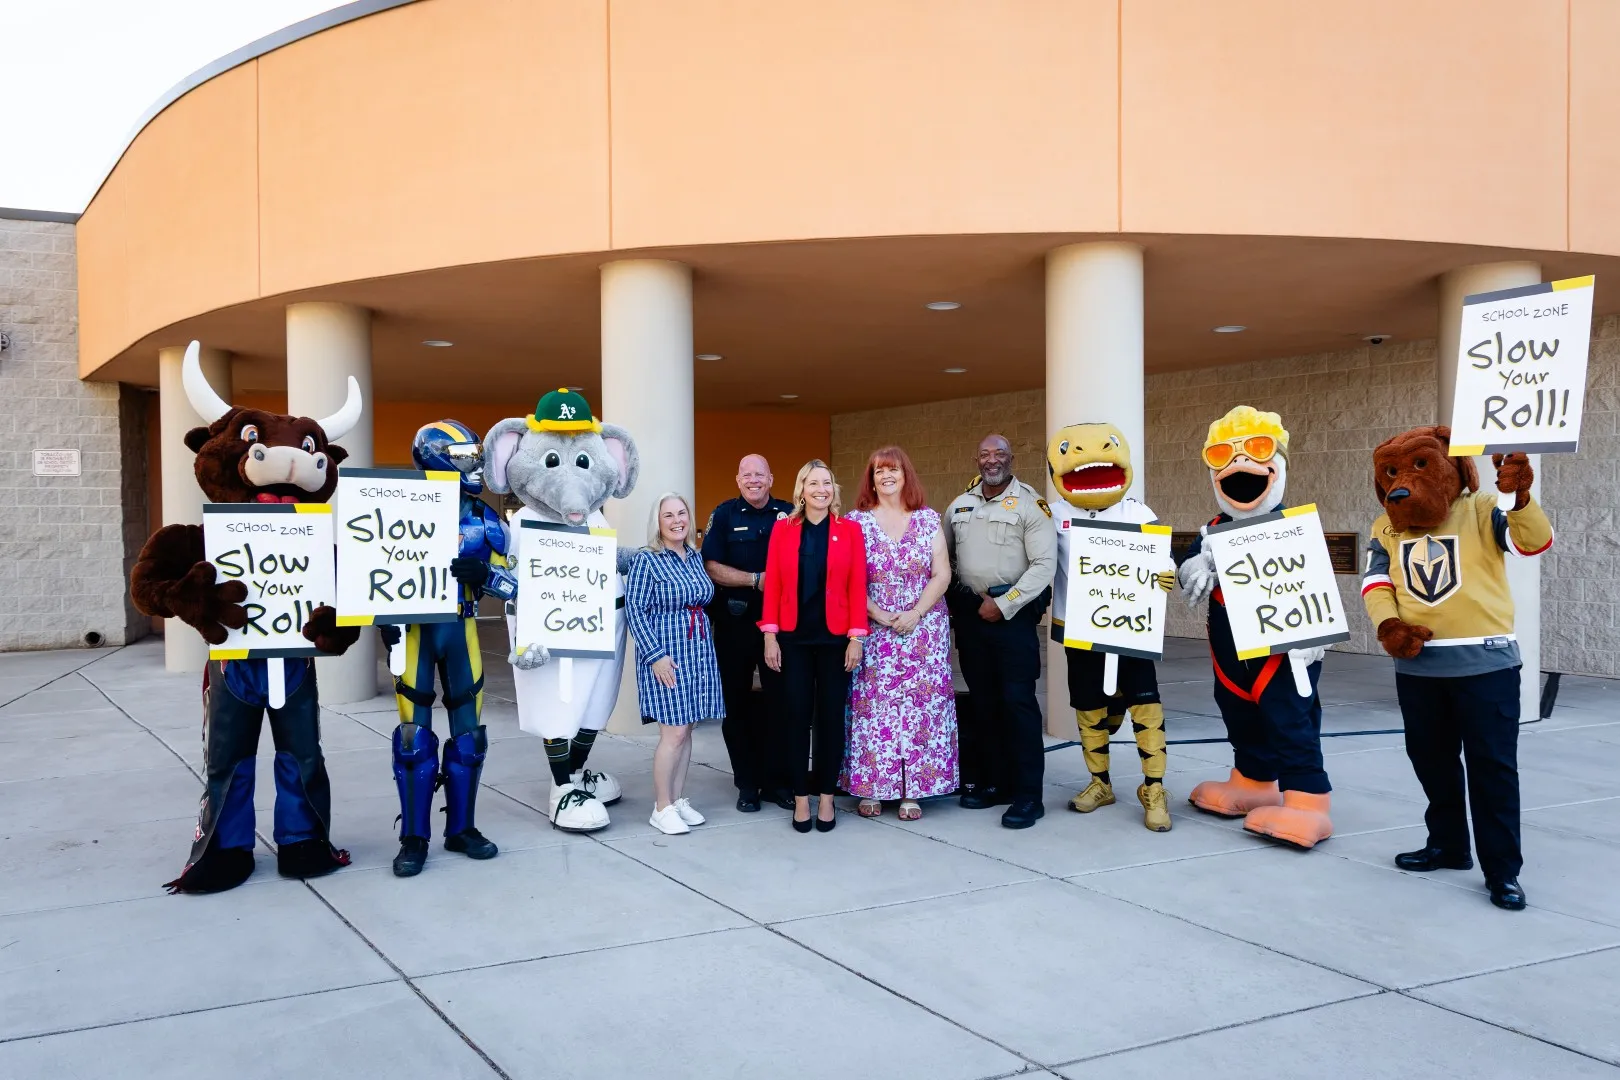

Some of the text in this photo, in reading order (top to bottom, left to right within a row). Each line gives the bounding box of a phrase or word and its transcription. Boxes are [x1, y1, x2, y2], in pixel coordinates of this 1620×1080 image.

[1481, 303, 1569, 322] SCHOOL ZONE
[1467, 332, 1560, 370] Slow
[557, 403, 576, 419] A's
[1481, 388, 1570, 431] Roll!
[359, 487, 442, 503] SCHOOL ZONE
[225, 522, 314, 536] SCHOOL ZONE
[346, 508, 436, 543] Slow
[1228, 525, 1305, 547] SCHOOL ZONE
[538, 538, 605, 555] SCHOOL ZONE
[1088, 536, 1157, 554] SCHOOL ZONE
[215, 543, 310, 578] Slow
[1079, 556, 1160, 590] Ease Up
[1225, 553, 1306, 585] Slow
[369, 566, 448, 602] Roll!
[529, 558, 608, 591] Ease Up
[541, 589, 588, 603] on the
[1089, 587, 1136, 602] on the
[543, 607, 605, 633] Gas!
[1091, 605, 1153, 632] Gas!
[1255, 591, 1335, 635] Roll!
